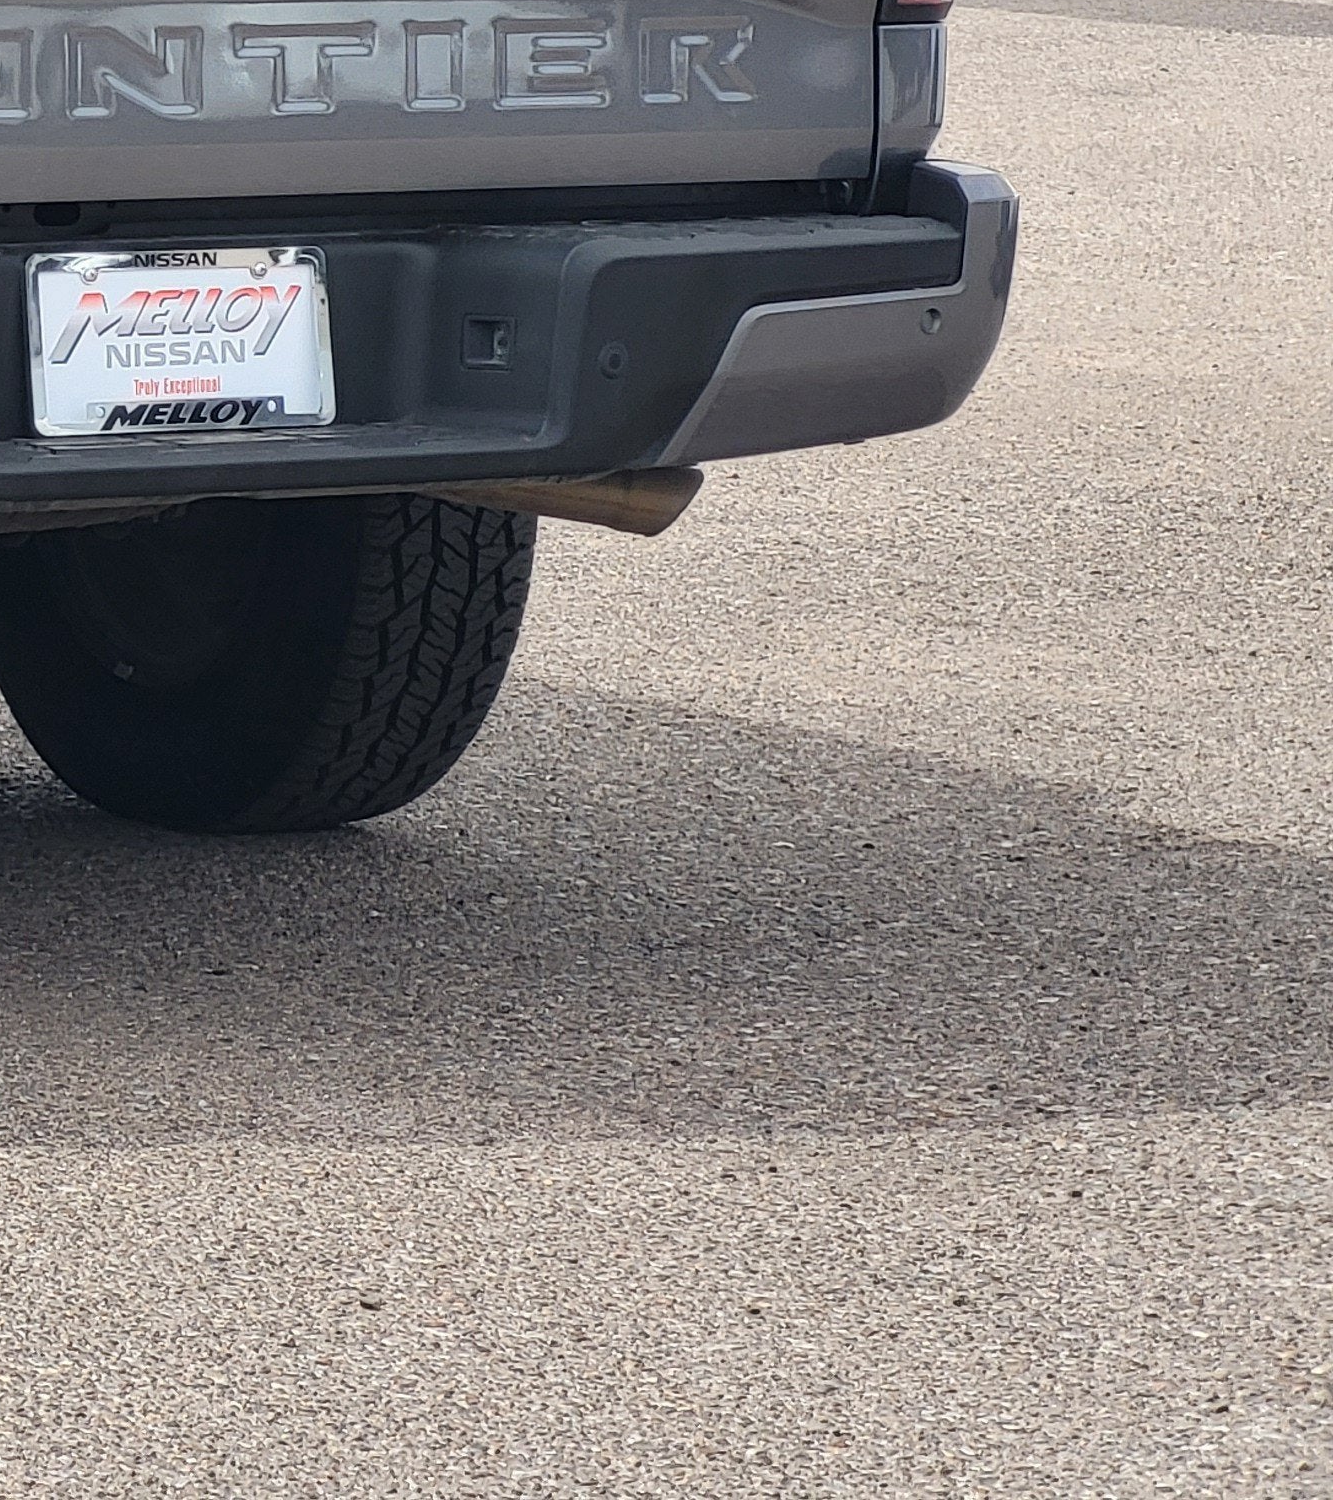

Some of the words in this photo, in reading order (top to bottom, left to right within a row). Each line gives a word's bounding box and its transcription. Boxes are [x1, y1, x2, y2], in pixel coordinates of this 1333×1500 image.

[134, 251, 217, 268] NISSAN
[49, 285, 302, 365] MELLOY
[106, 339, 245, 368] NISSAN
[134, 378, 159, 397] Truly
[164, 375, 221, 395] Exceptional
[100, 400, 263, 432] MELLOY
